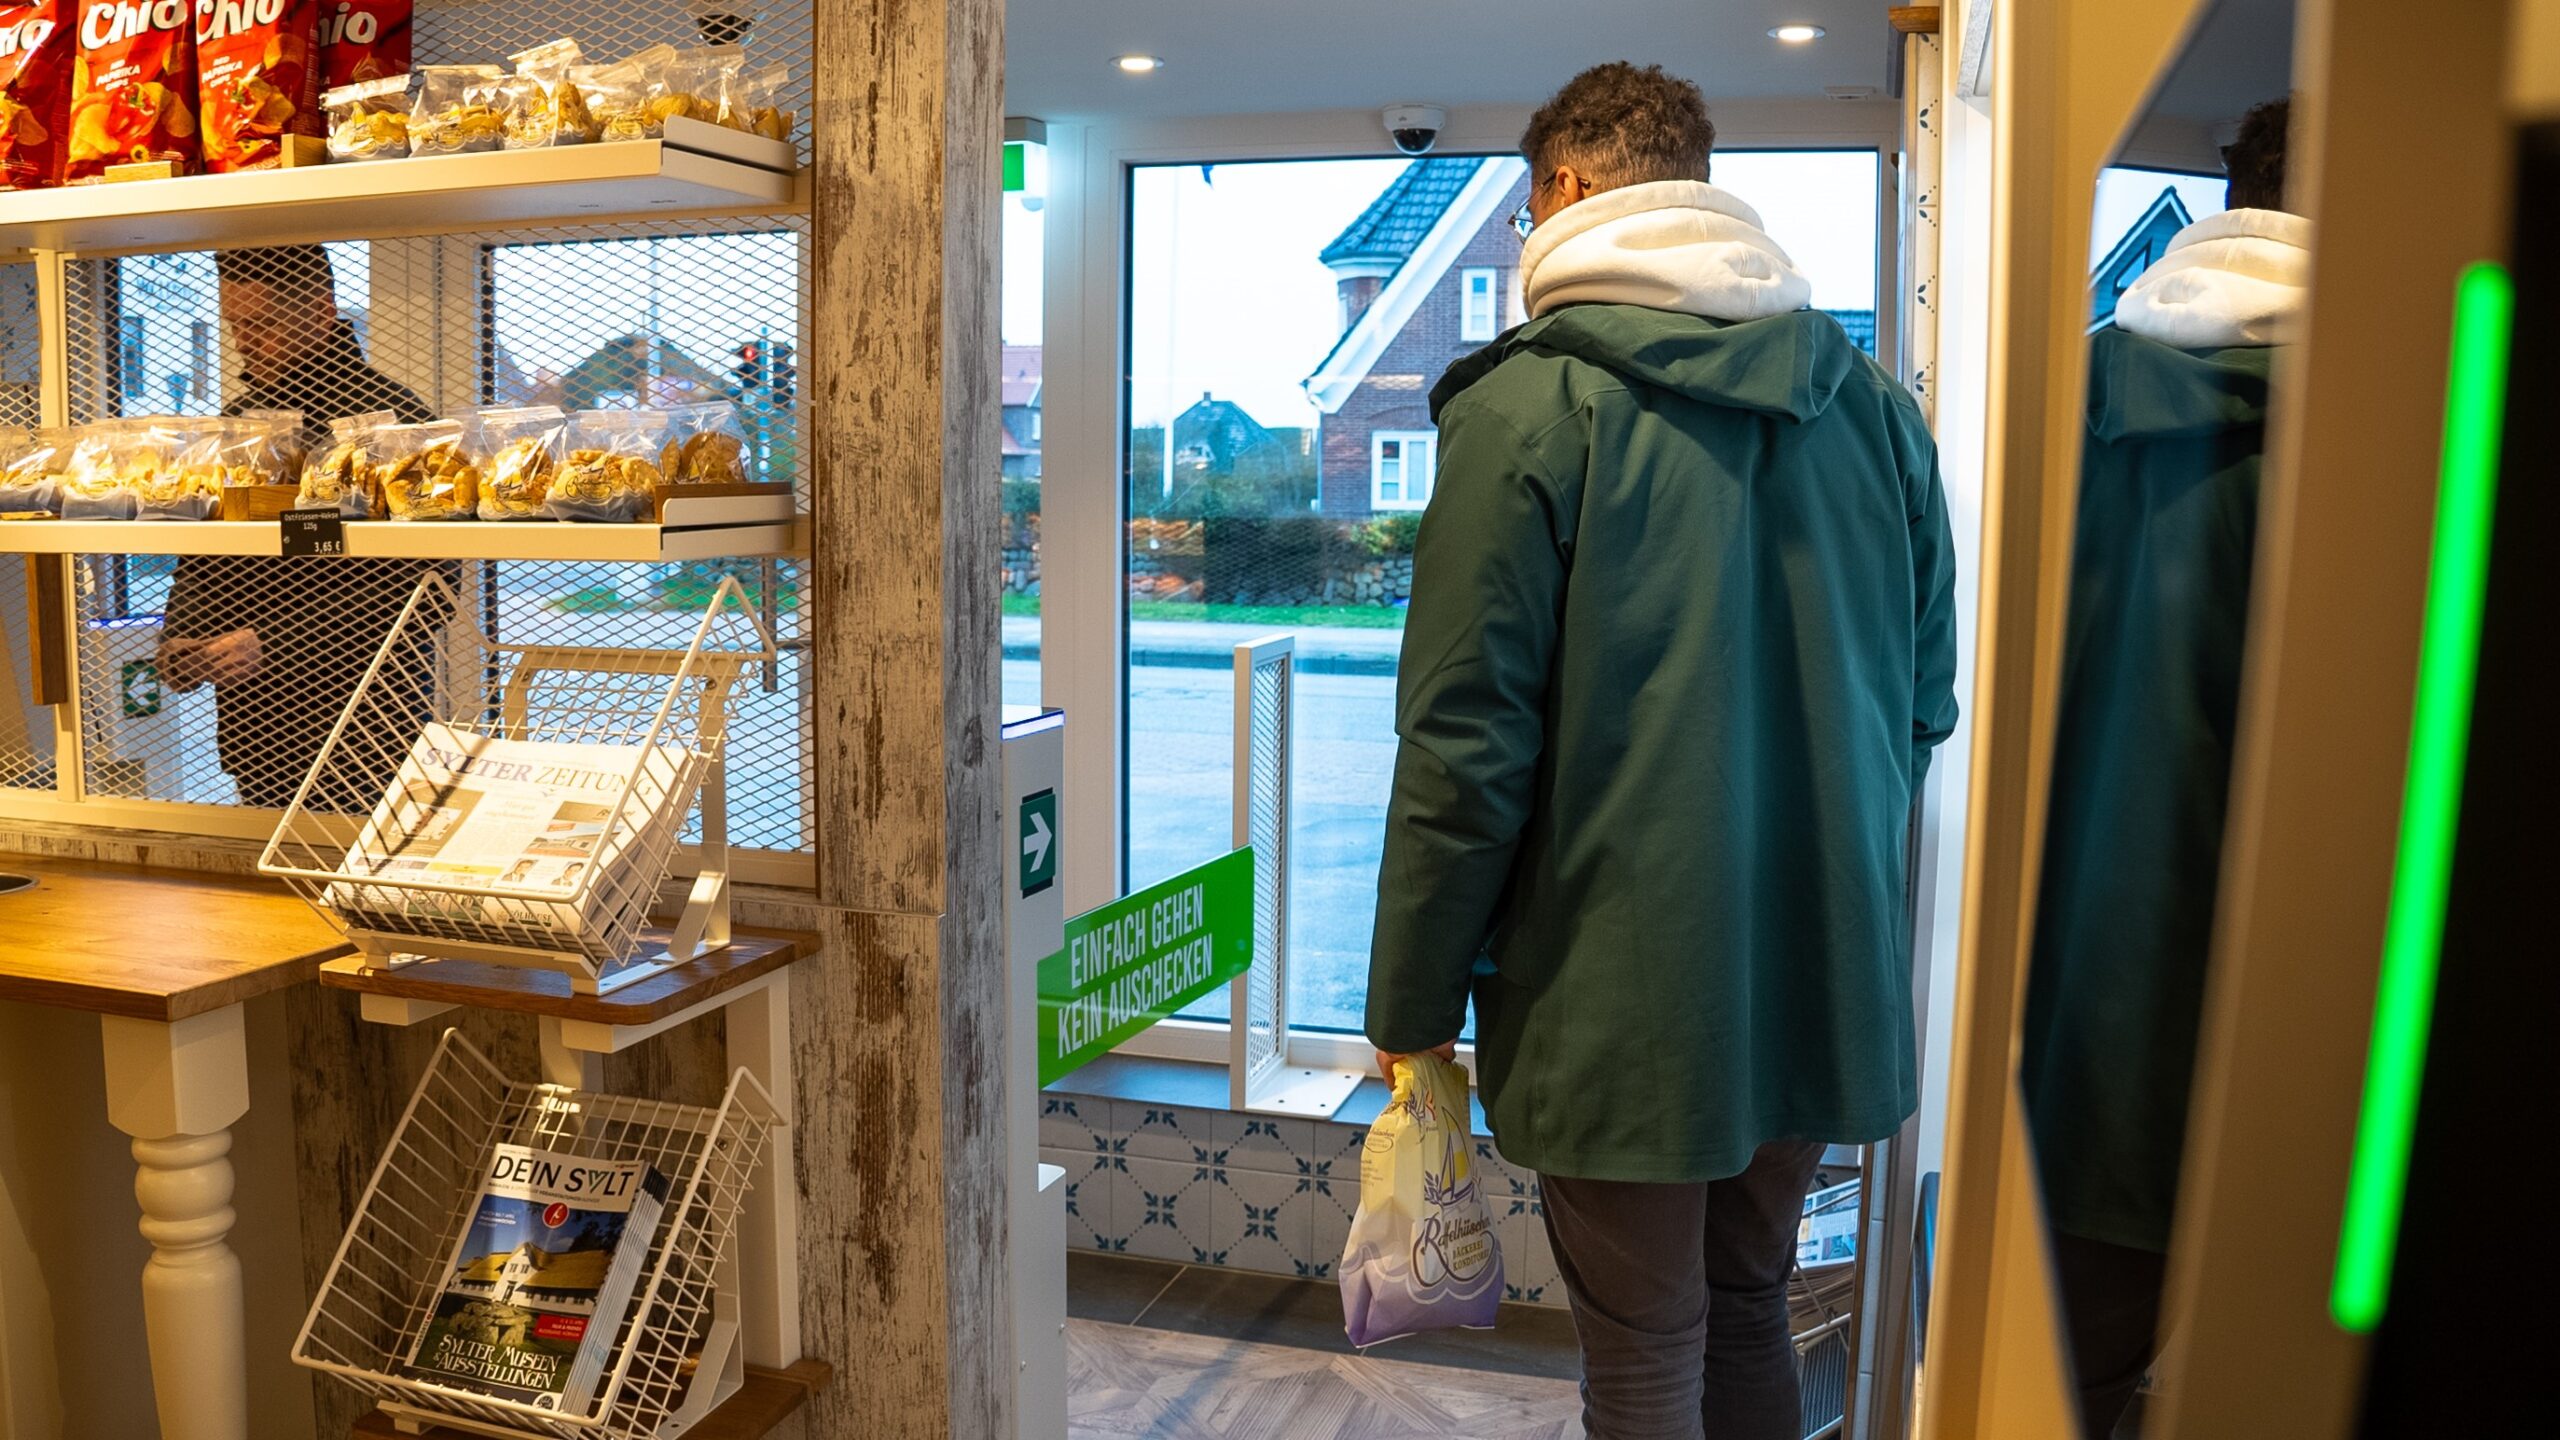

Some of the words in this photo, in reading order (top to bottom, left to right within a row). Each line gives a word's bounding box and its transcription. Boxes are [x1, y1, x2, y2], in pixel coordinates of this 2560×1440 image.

[81, 0, 188, 50] Chio
[195, 0, 286, 46] Chio
[314, 541, 333, 553] 3,65
[335, 541, 341, 551] €
[421, 748, 533, 783] SYLTER
[534, 765, 653, 796] ZEITUNG
[1071, 908, 1146, 989] EINFACH
[1152, 883, 1203, 949] GEHEN
[1058, 989, 1102, 1059] KEIN
[1108, 933, 1212, 1032] AUSCHECKEN
[491, 1155, 562, 1188] DEIN
[564, 1168, 634, 1196] SYLT
[436, 1352, 556, 1389] AUSSTELLUNGEN
[438, 1334, 496, 1363] SYLTER
[497, 1346, 562, 1372] MUSEEN
